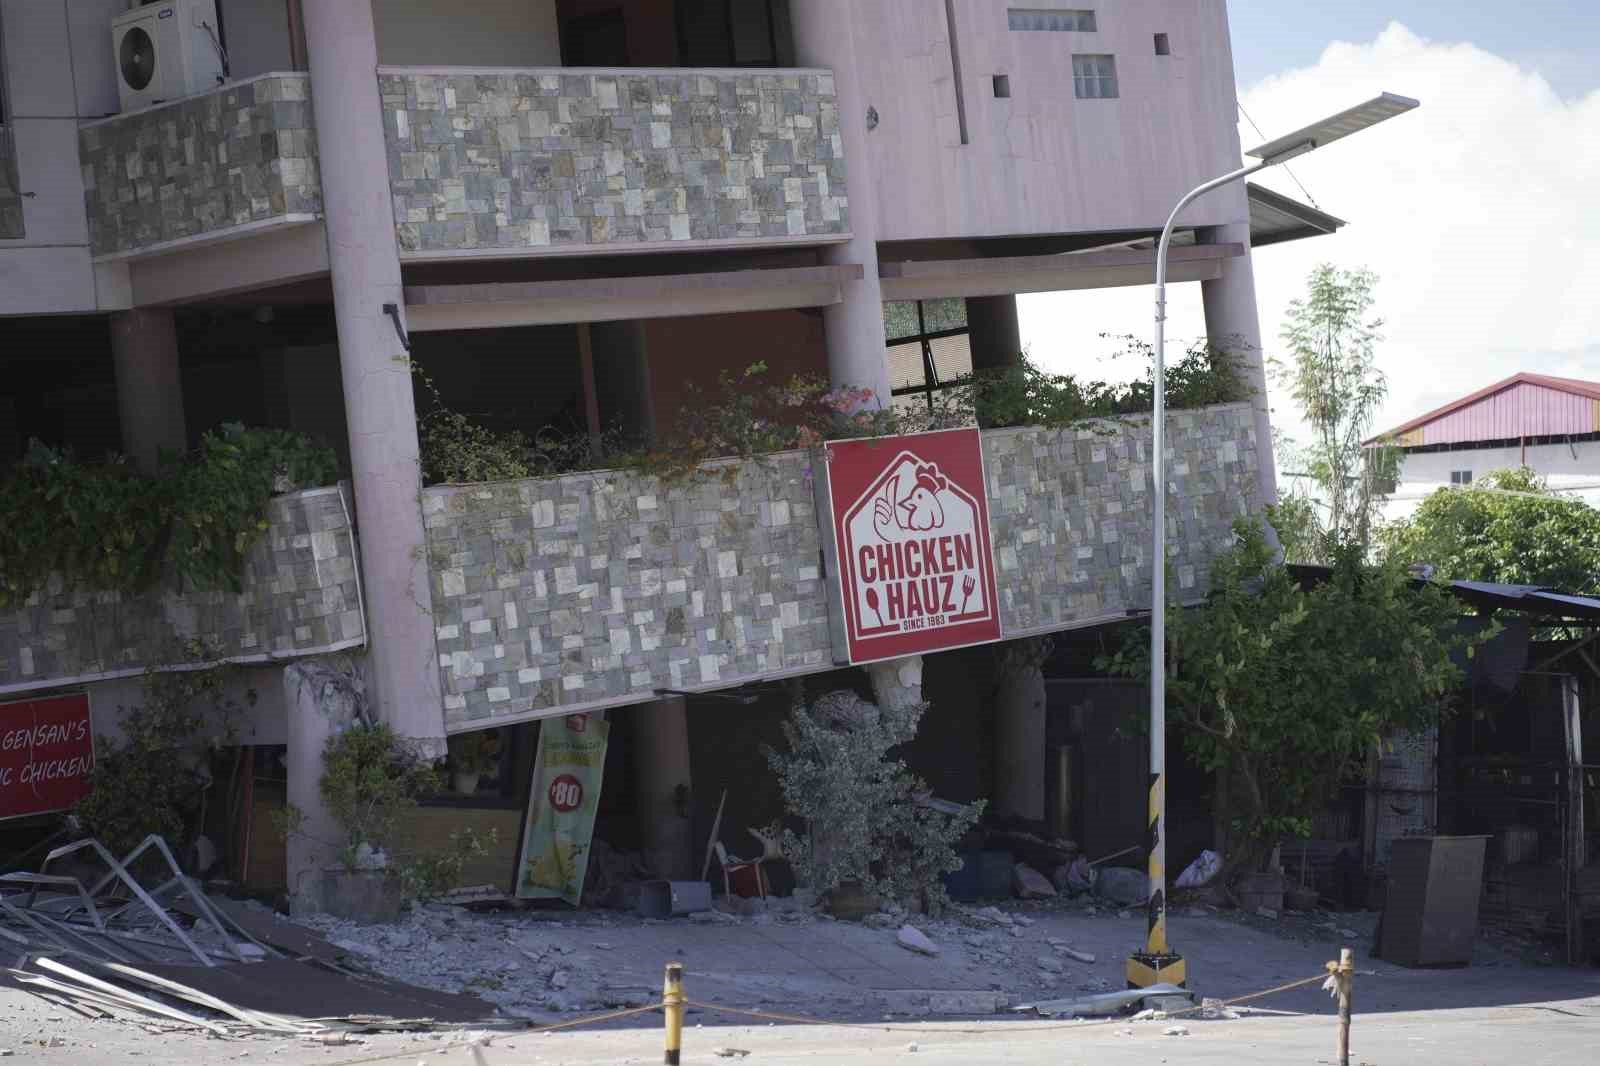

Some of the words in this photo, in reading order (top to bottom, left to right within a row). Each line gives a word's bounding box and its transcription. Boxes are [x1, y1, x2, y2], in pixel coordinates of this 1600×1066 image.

[858, 533, 975, 584] CHICKEN
[886, 575, 957, 621] HAUZ
[903, 617, 925, 631] SINCE
[928, 614, 945, 626] 1983
[2, 719, 88, 750] GENSAN'S
[20, 753, 92, 784] CHICKEN
